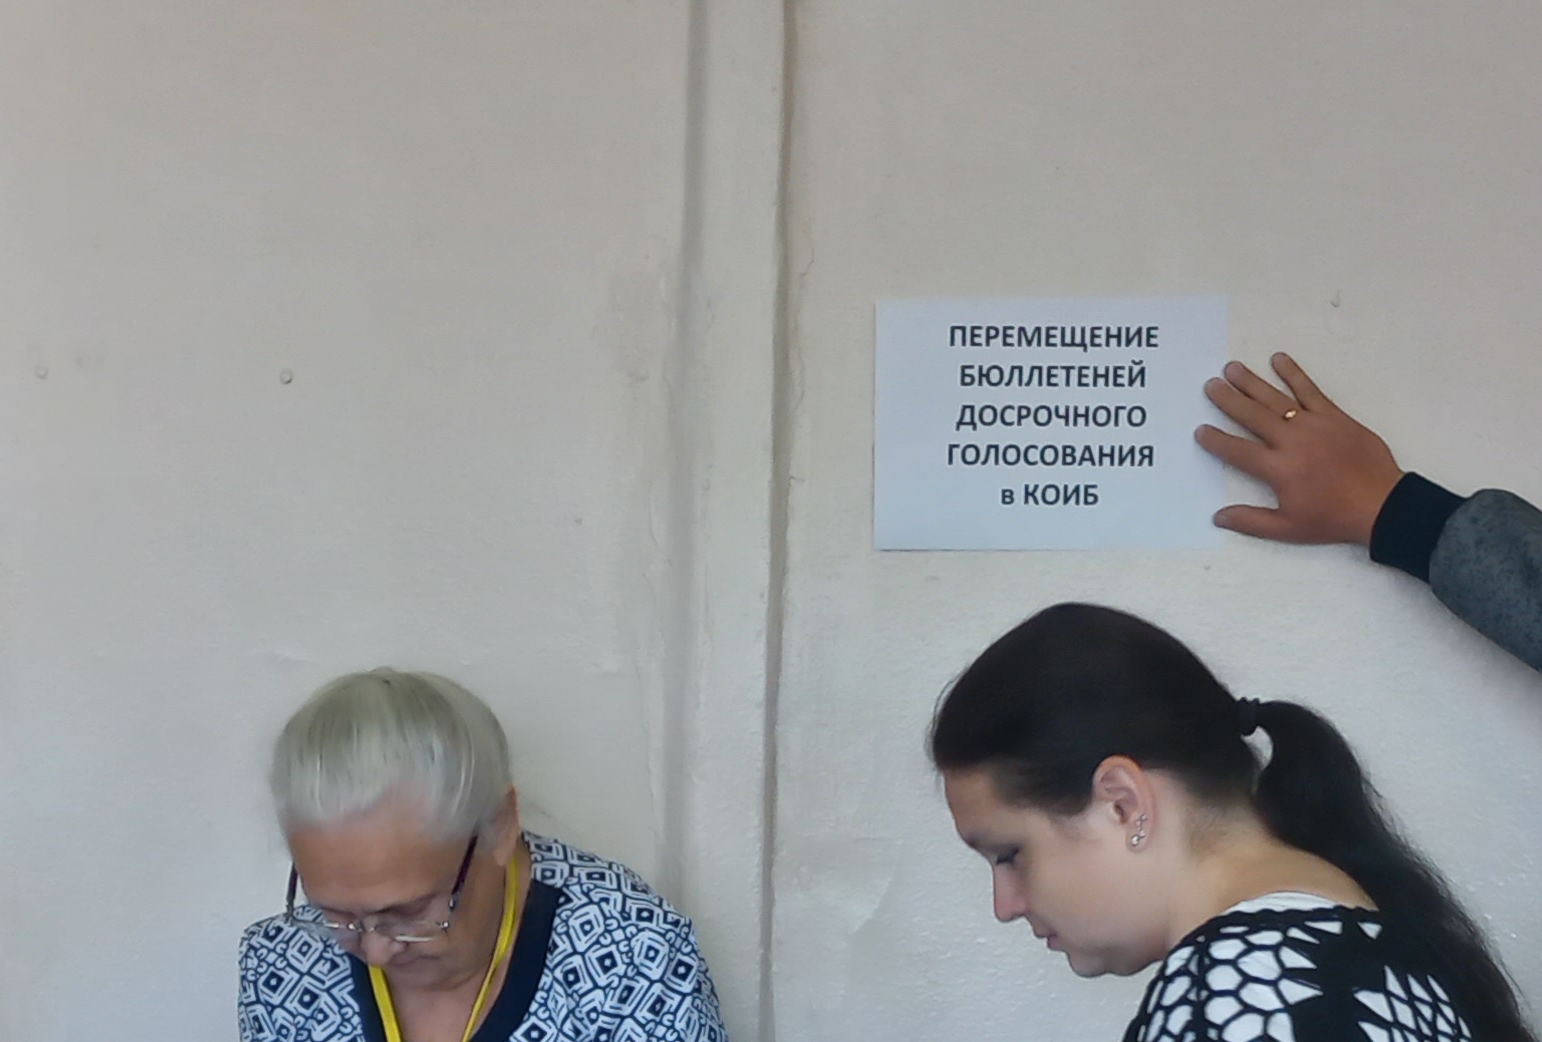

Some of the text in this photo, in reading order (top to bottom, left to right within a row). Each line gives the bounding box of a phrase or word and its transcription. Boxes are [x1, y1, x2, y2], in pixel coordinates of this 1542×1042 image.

[948, 325, 1160, 352] ПЕРЕМЕЩЕНИЕ
[959, 358, 1147, 388] БЮЛЛЕТЕНЕЙ
[955, 404, 1148, 431] ДОСРОЧНОГО
[947, 443, 1155, 467] ГОЛОСОВАНИЯ
[1000, 483, 1100, 506] в КОИБ
